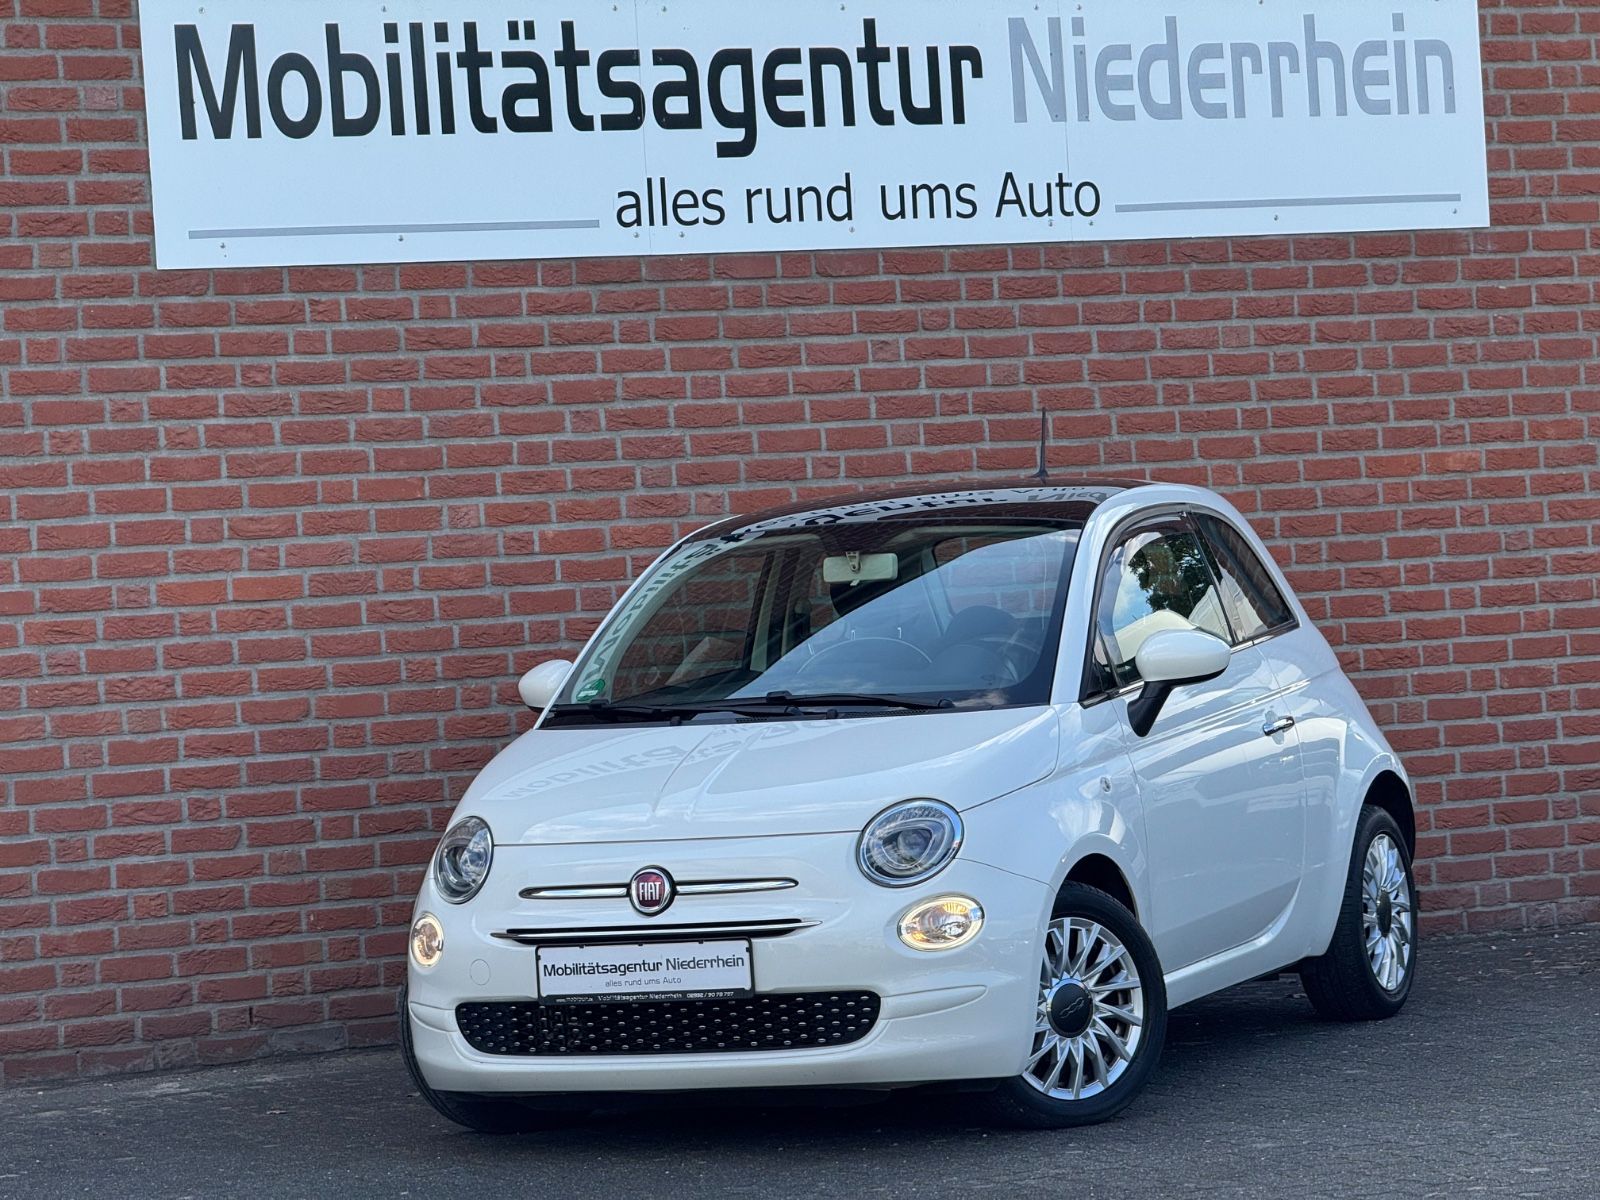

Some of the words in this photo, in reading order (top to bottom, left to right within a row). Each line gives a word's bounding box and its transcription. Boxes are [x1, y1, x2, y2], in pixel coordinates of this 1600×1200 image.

[173, 17, 984, 158] Mobilitätsagentur
[1008, 12, 1457, 123] Niederrhein
[616, 177, 726, 228] alles
[745, 172, 854, 224] rund
[880, 181, 978, 221] ums
[995, 171, 1101, 219] Auto
[638, 881, 662, 901] FIAT
[543, 959, 663, 978] Mobilitätsagentur
[665, 955, 745, 971] Niederrhein
[605, 979, 623, 987] alles
[624, 978, 642, 987] rund
[662, 976, 682, 985] Auto
